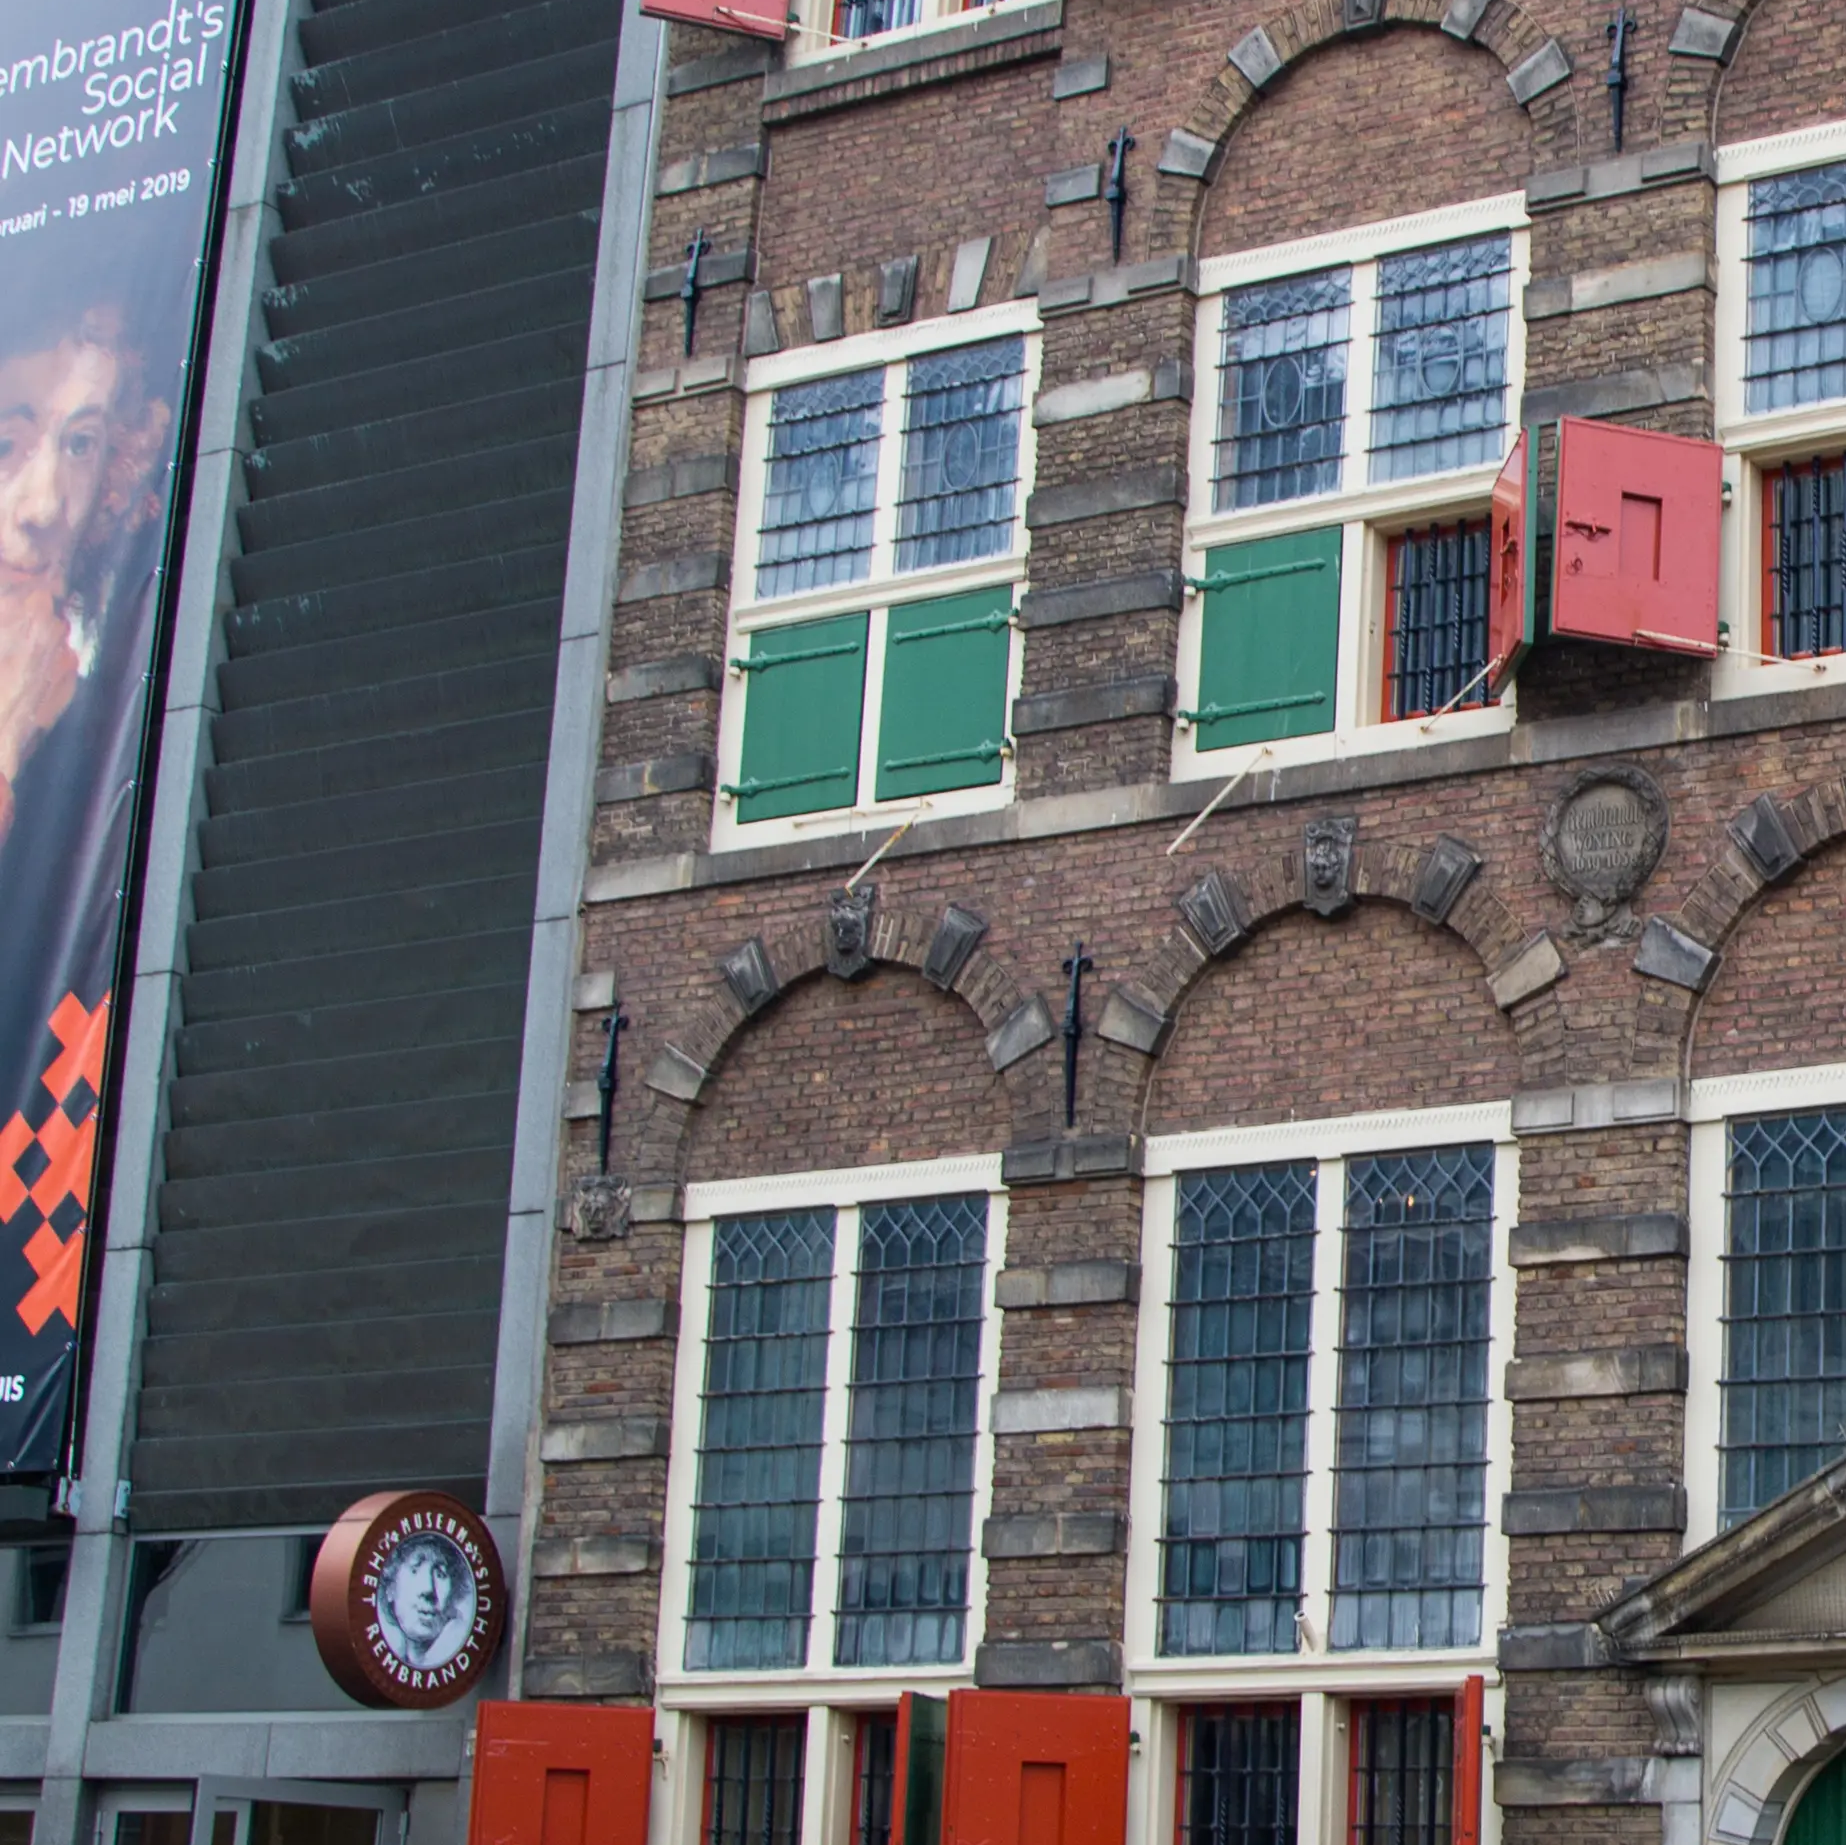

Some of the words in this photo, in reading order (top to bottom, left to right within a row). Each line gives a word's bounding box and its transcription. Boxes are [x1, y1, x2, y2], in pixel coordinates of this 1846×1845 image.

[81, 42, 208, 115] Social
[2, 102, 180, 180] Network
[0, 204, 47, 238] ruari
[69, 195, 89, 219] 19
[95, 181, 136, 212] mei
[140, 169, 191, 200] 2019
[1570, 829, 1634, 852] WONING
[400, 1511, 469, 1545] MUSEUM
[361, 1551, 385, 1608] HET
[365, 1566, 492, 1689] REMBRANDTHUIS
